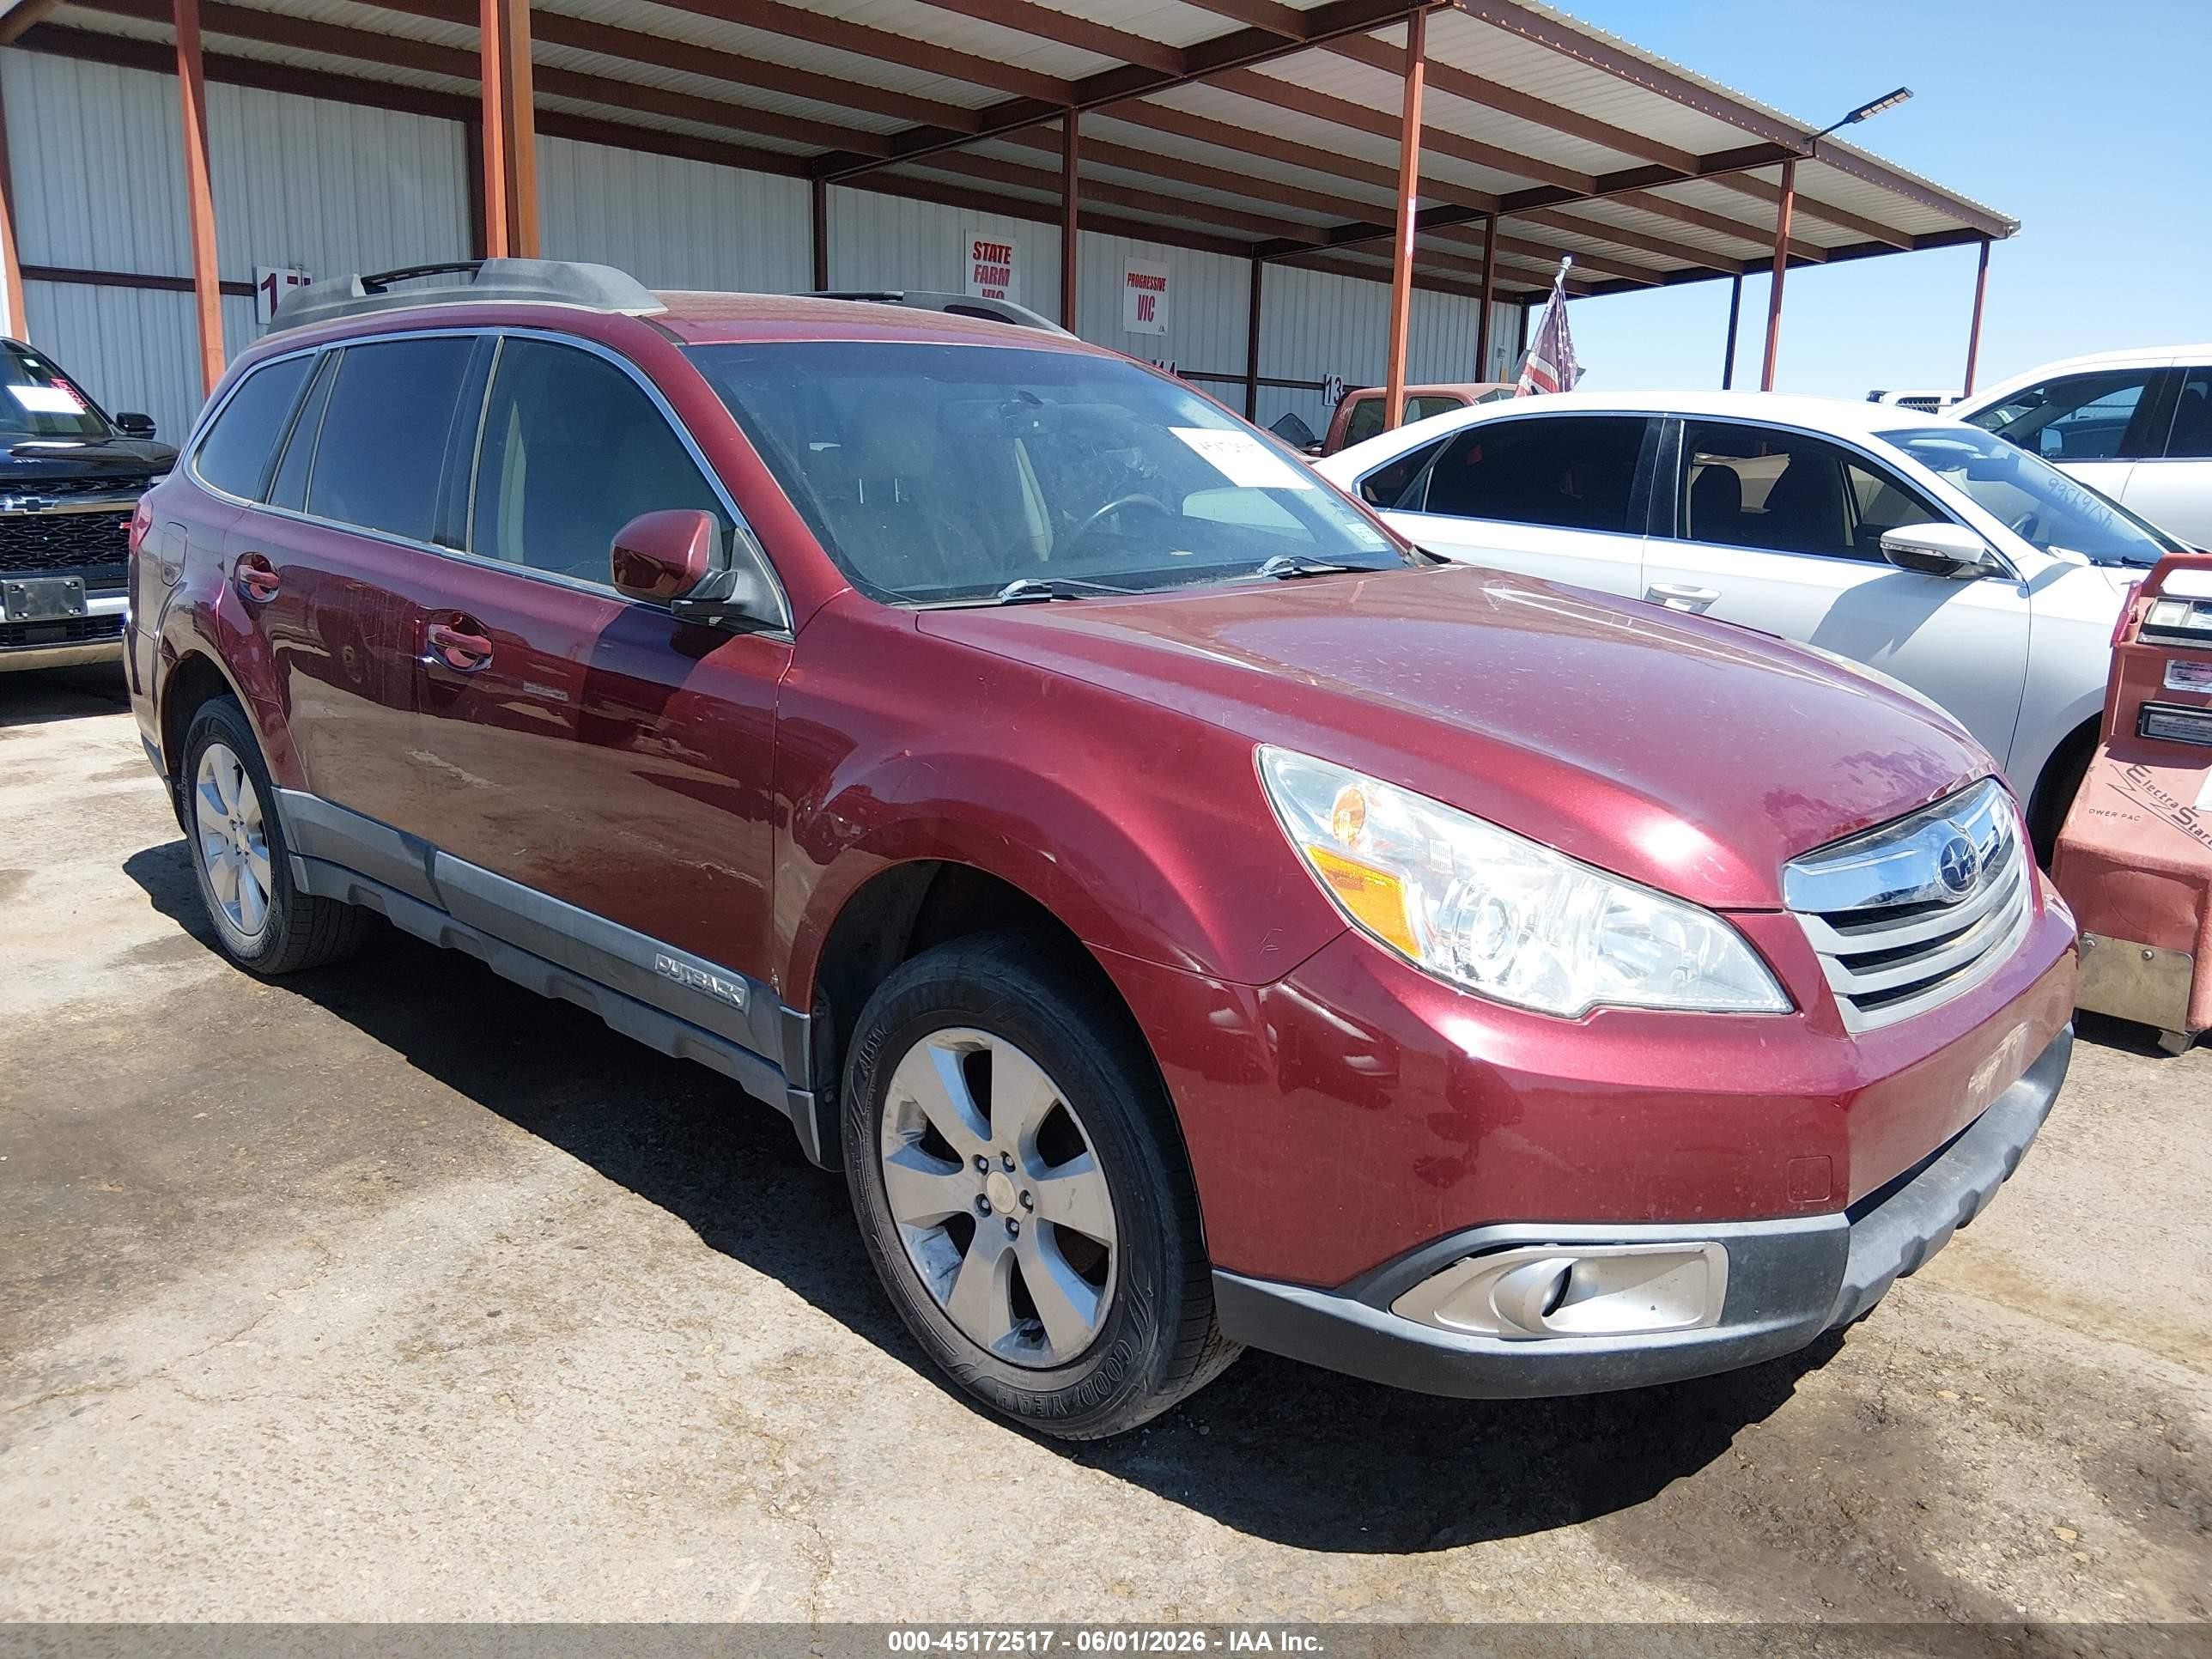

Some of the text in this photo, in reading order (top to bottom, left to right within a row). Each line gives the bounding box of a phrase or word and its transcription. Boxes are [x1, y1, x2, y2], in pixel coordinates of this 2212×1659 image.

[973, 241, 1012, 264] STATE
[974, 264, 1011, 287] FARM
[1127, 273, 1166, 292] PROGRESSIVE
[260, 272, 311, 317] 1
[1137, 295, 1155, 322] VIC
[1326, 375, 1342, 404] 13
[2126, 763, 2179, 808] Electra
[657, 954, 742, 1005] OUTBACK
